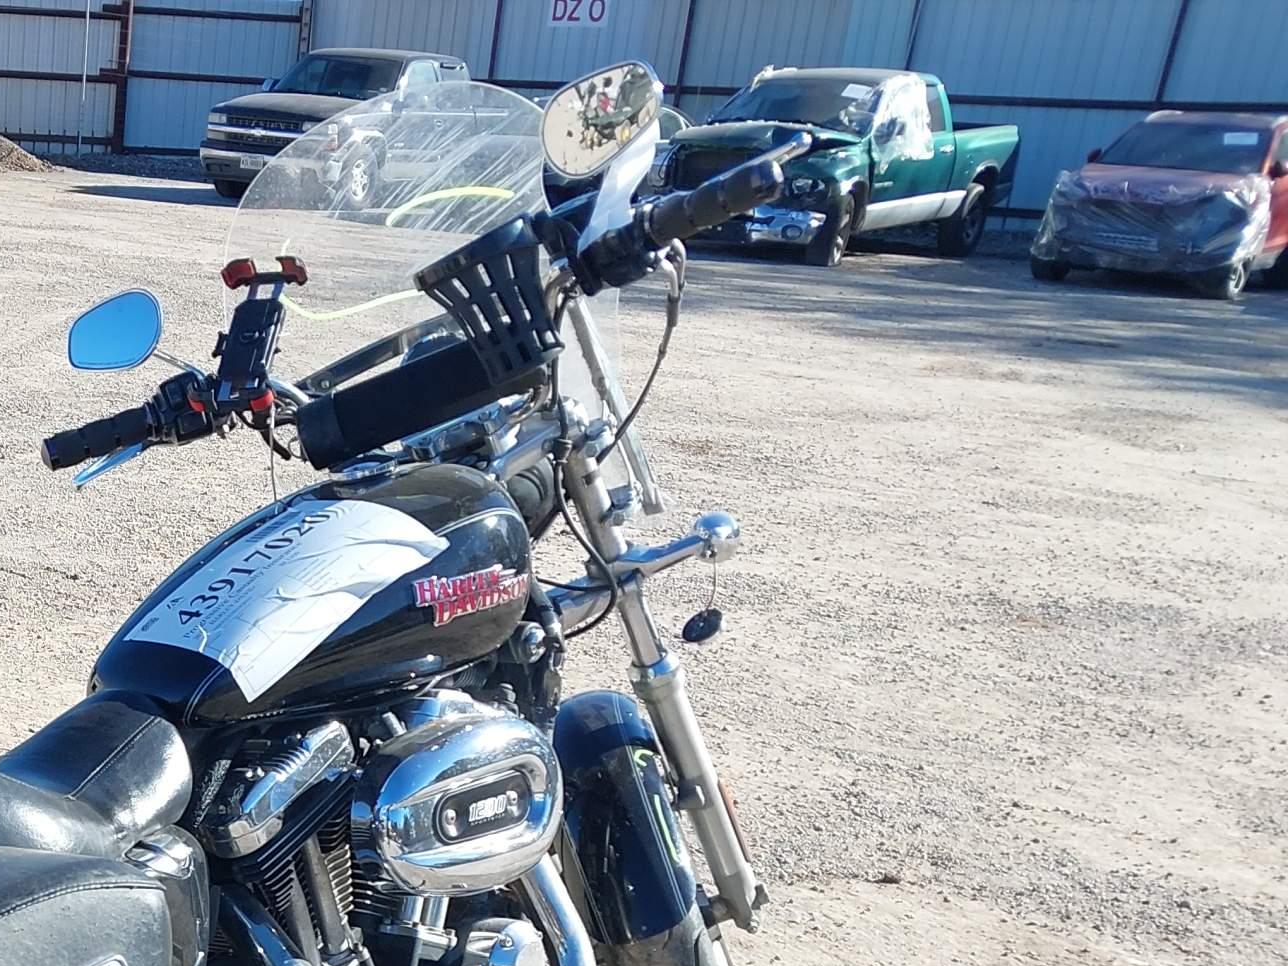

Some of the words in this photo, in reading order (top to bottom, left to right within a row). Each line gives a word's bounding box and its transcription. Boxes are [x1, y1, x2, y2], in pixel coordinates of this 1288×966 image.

[178, 514, 330, 625] 43917020
[415, 565, 501, 606] HARLEY
[434, 574, 529, 627] DAVIDSON
[468, 794, 508, 822] 1200
